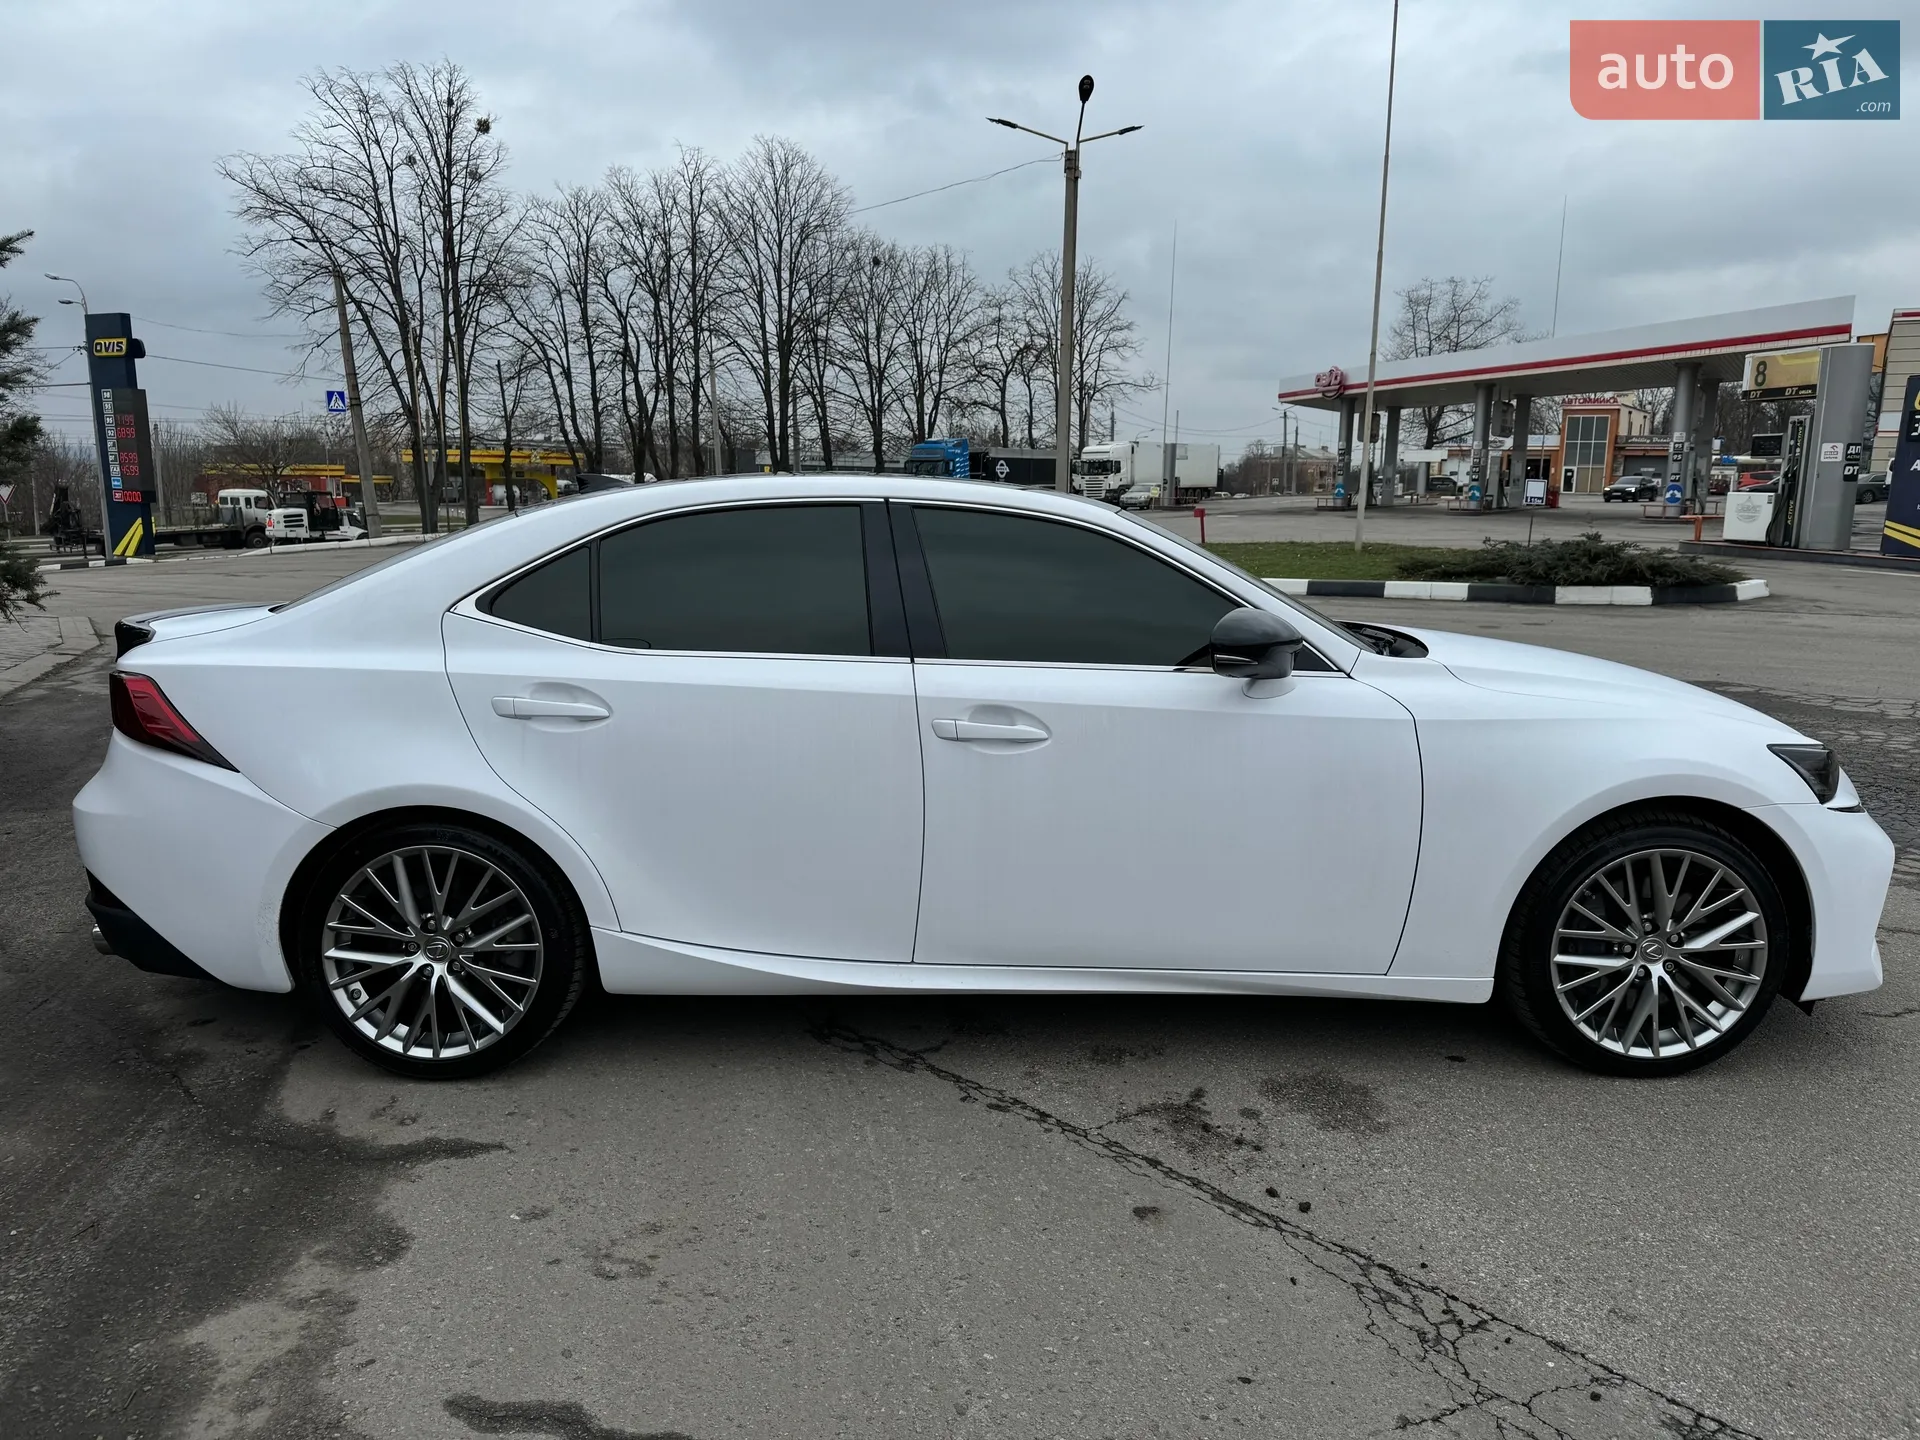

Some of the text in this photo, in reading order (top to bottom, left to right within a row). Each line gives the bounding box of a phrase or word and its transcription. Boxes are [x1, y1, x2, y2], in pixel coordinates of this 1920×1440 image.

[95, 341, 125, 353] OVIS
[1754, 360, 1768, 388] 8
[1749, 391, 1763, 399] DT
[1784, 387, 1798, 396] DT
[1844, 465, 1860, 475] DT
